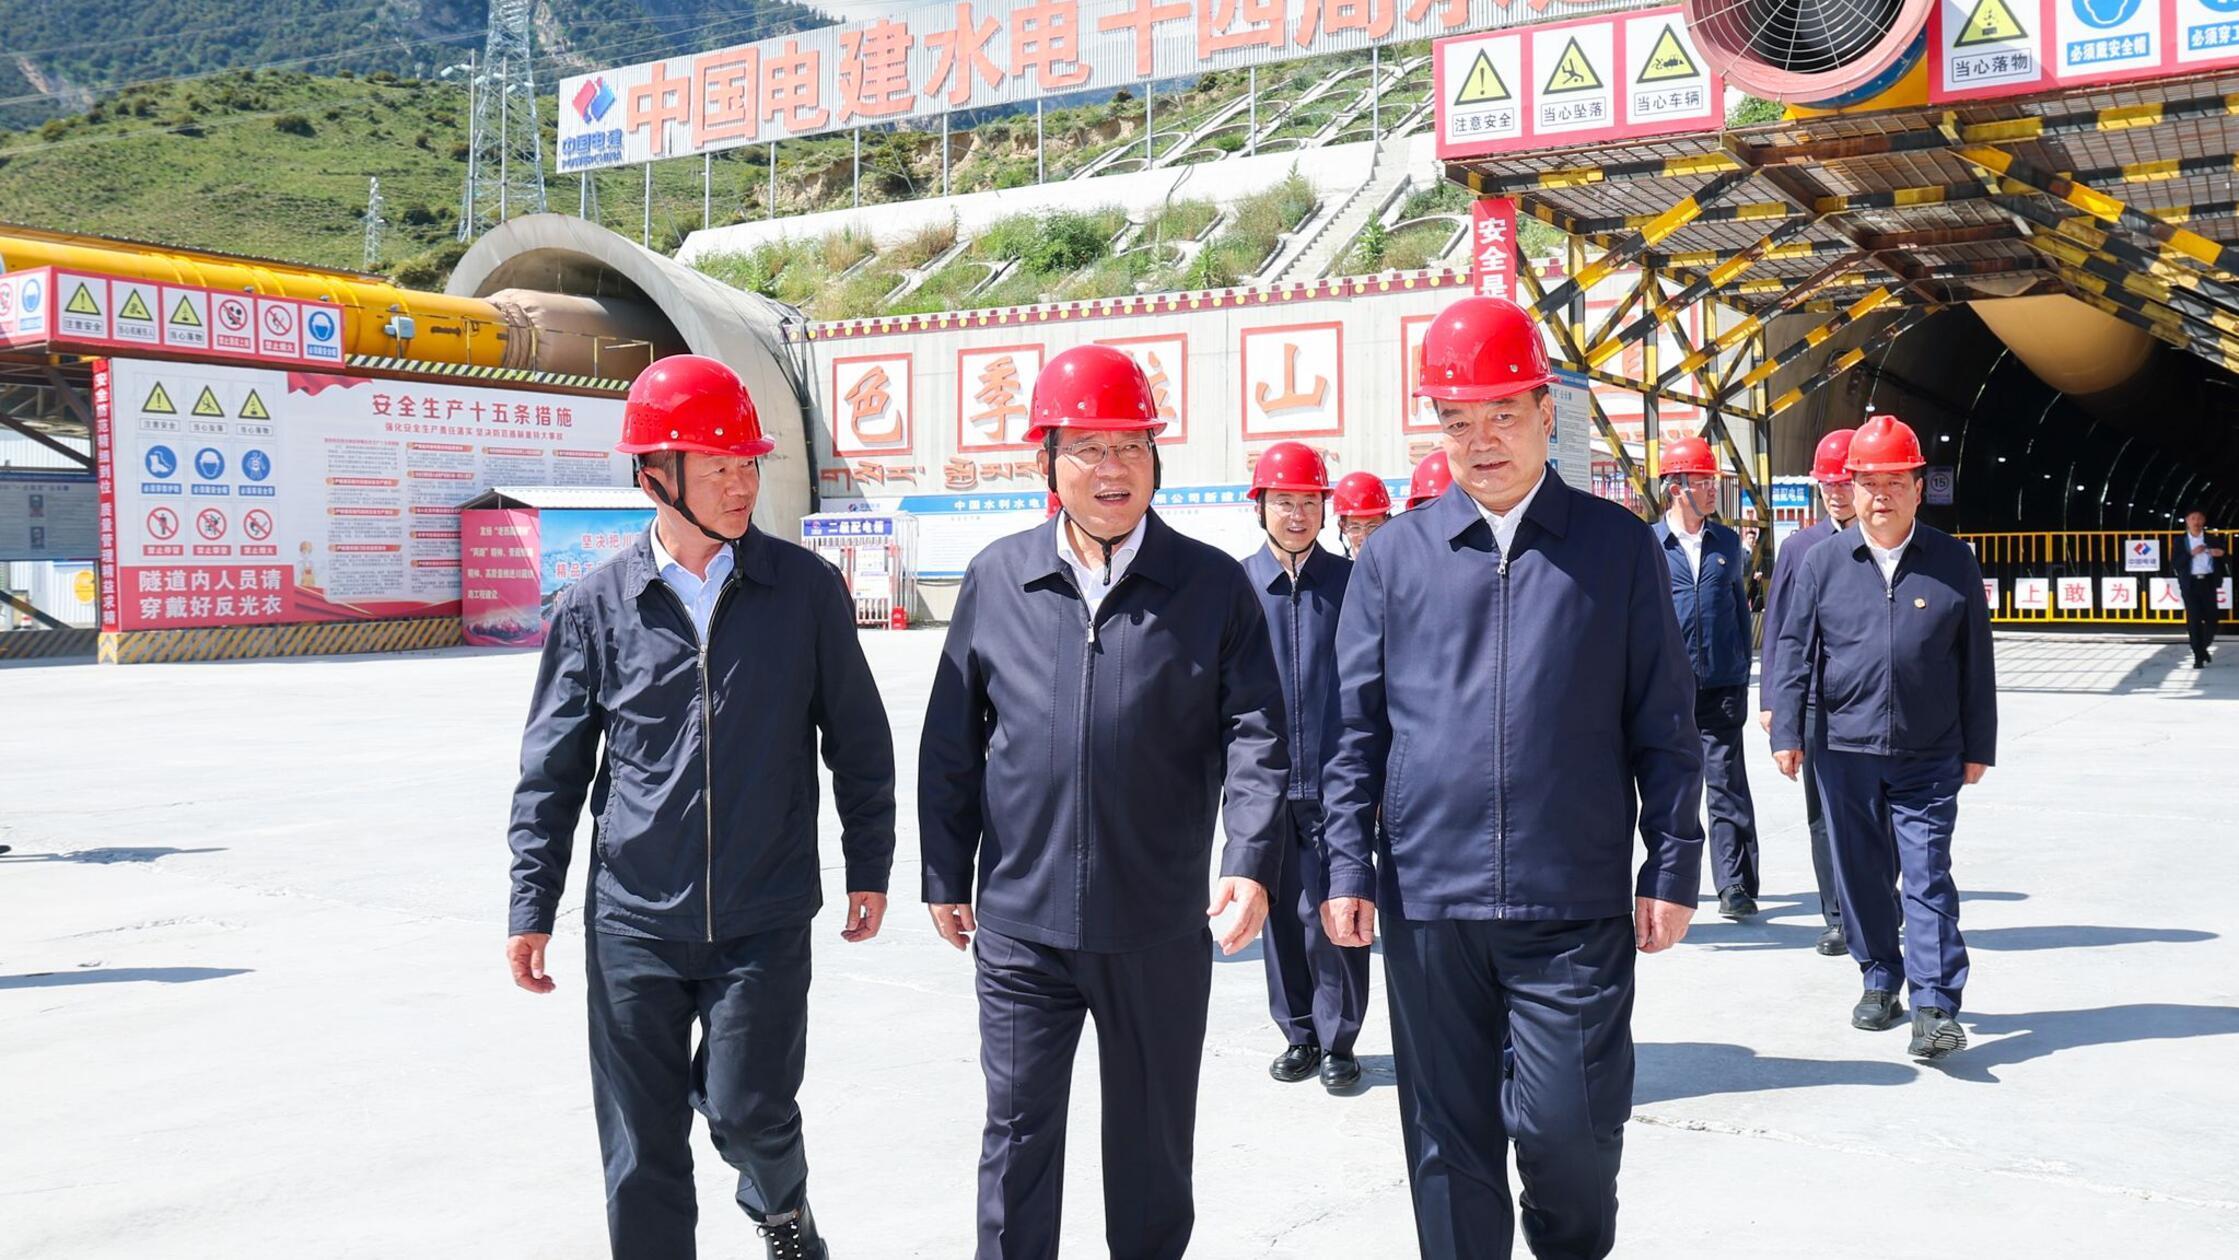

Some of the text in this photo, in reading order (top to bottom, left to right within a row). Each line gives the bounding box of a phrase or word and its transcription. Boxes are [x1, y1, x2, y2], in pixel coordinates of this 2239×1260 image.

[2070, 35, 2147, 62] 必须戴安全帽
[1955, 54, 2029, 78] 当心落物
[1637, 90, 1700, 112] 当心车辆
[1543, 102, 1603, 123] 当心坠落
[1454, 113, 1512, 133] 注意安全
[562, 128, 623, 155] 中国电建
[1478, 216, 1508, 298] 安全是
[65, 319, 101, 332] 注意安全
[170, 331, 203, 342] 当心落物
[265, 341, 293, 352] 禁止烟火
[372, 393, 573, 428] 安全生产十五条措施
[144, 420, 176, 430] 注意安全
[1935, 478, 1946, 488] 15
[954, 497, 1048, 511] 中国水利水电
[828, 520, 885, 534] 二级配电箱
[582, 532, 639, 549] 坚决把川
[138, 569, 282, 593] 隧道内人员请
[139, 594, 283, 620] 穿戴好反光衣
